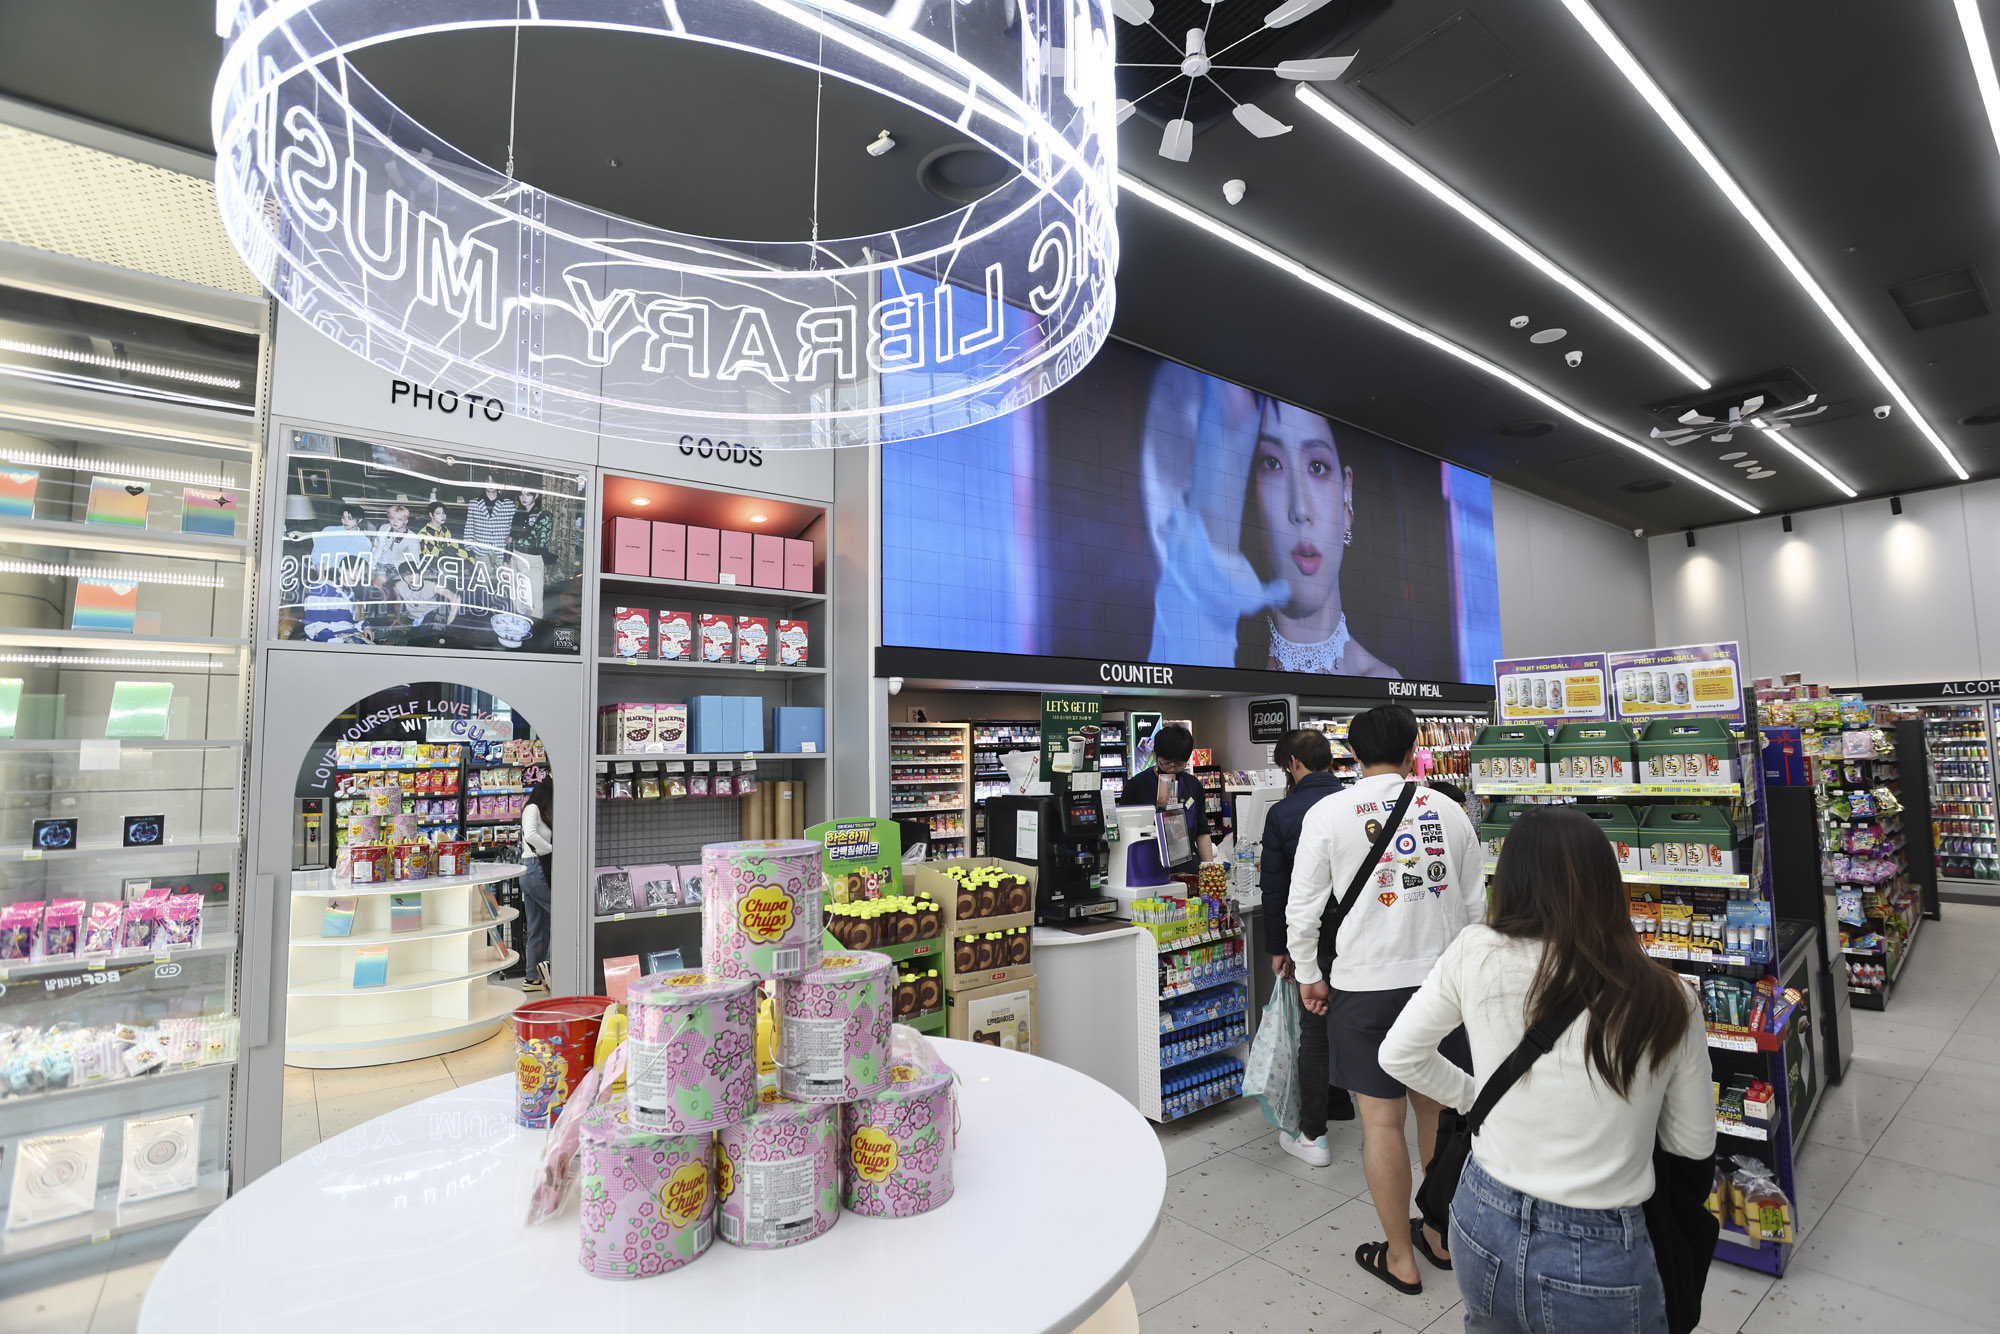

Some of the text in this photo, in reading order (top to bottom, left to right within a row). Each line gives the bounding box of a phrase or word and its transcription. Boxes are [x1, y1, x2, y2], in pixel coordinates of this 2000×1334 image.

[391, 380, 504, 421] PHOTO
[679, 434, 763, 467] GOODS
[1634, 650, 1730, 665] FRUIT HIGHBALL SET
[1100, 663, 1174, 685] COUNTER
[1536, 663, 1569, 671] HIGHBALL
[1389, 682, 1443, 698] READY MEAL
[1046, 699, 1099, 713] LET'S GET IT!
[626, 715, 654, 723] BLACKPINK
[1254, 711, 1284, 727] 13000
[401, 716, 486, 741] WITH CU
[311, 748, 342, 789] LOVE
[337, 700, 419, 746] YOURSELF
[427, 700, 470, 717] LOVE
[477, 709, 512, 738] YOUR
[1072, 747, 1081, 755] get
[1420, 823, 1442, 831] APE
[826, 830, 869, 846] 한손한끼
[1423, 836, 1444, 844] APE
[831, 843, 880, 858] 단백질쉐이크
[745, 899, 788, 916] Chupa
[743, 913, 787, 936] Chups
[520, 1097, 535, 1106] FUN
[855, 1137, 892, 1155] Chupa
[853, 1150, 890, 1174] Chups
[669, 1173, 705, 1197] Chupa
[667, 1188, 704, 1218] Chups
